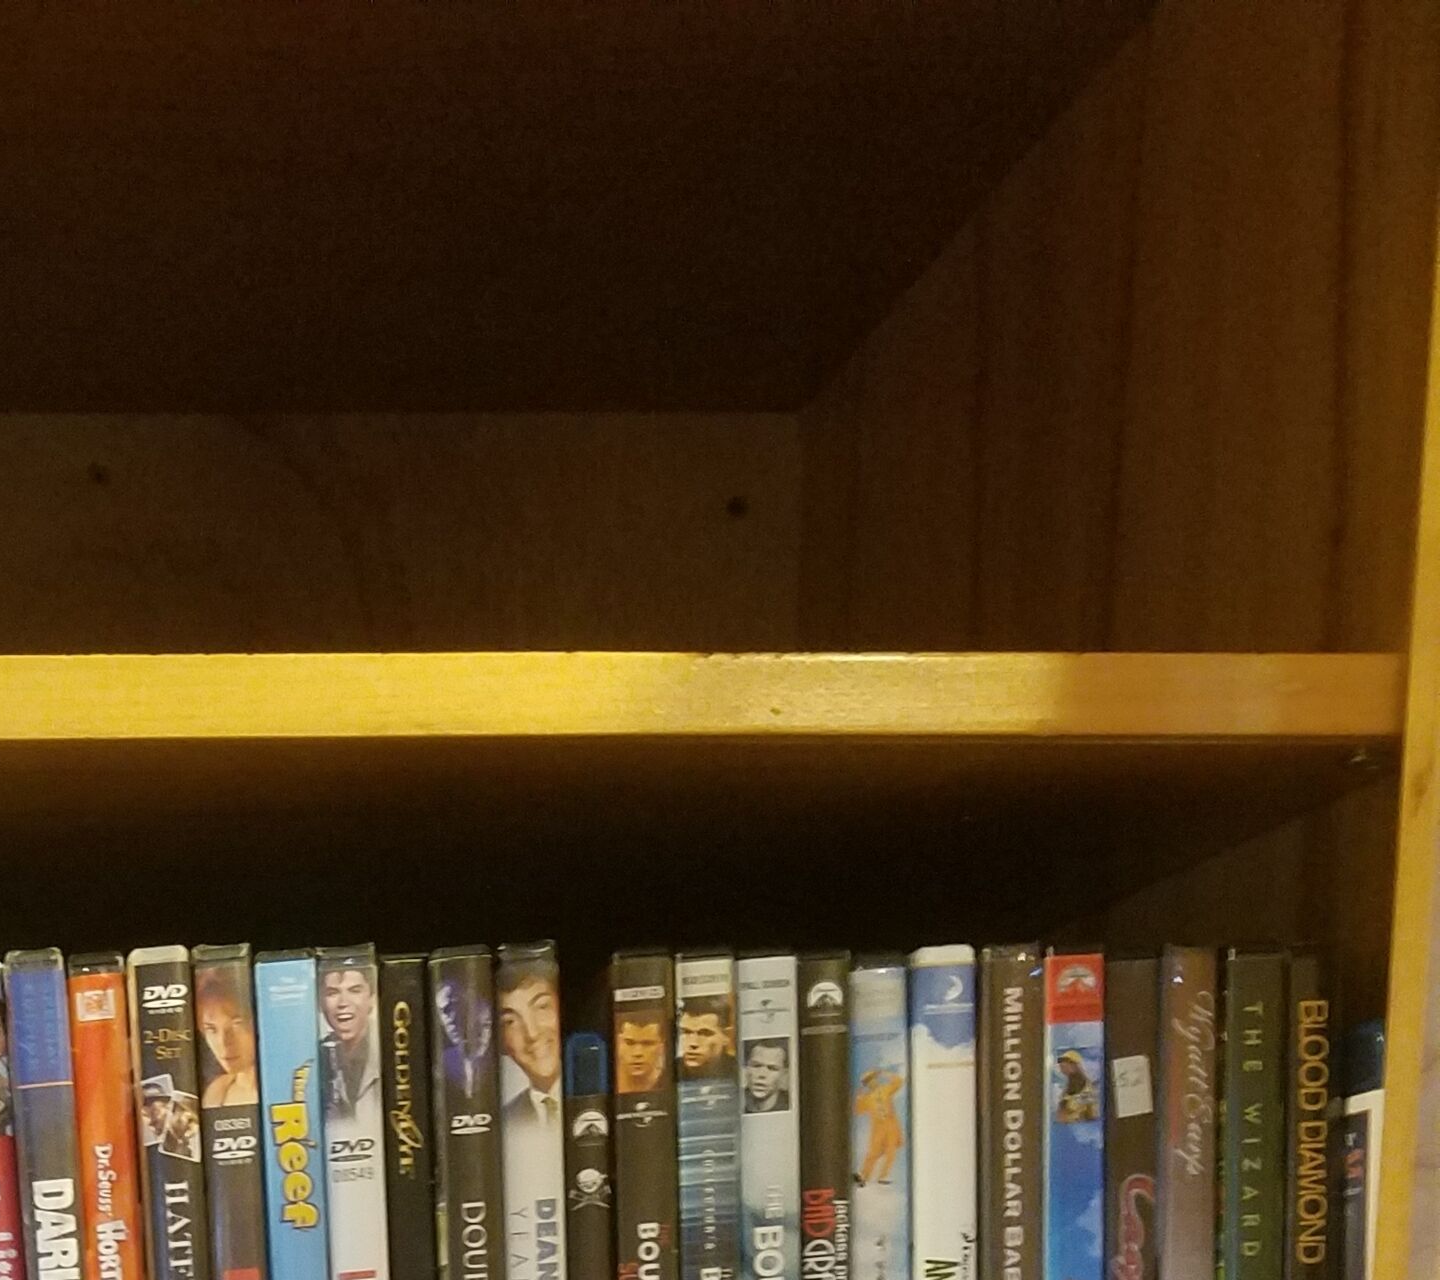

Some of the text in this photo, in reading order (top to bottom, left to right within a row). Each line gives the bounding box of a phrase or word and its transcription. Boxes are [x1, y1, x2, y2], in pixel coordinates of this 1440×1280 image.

[142, 984, 188, 1001] DVD
[1003, 988, 1024, 1101] MILLION
[1242, 1000, 1263, 1072] THE
[390, 1000, 423, 1177] GOLDENEYE
[450, 1112, 492, 1128] DVD
[1170, 991, 1215, 1177] Wyatt Earp
[1296, 999, 1329, 1264] BLOOD DIAMOND
[212, 1136, 257, 1152] DVD
[270, 1100, 320, 1231] Reef
[329, 1138, 375, 1156] DVD
[1003, 1109, 1024, 1217] DOLLAR
[1242, 1103, 1263, 1257] WIZARD
